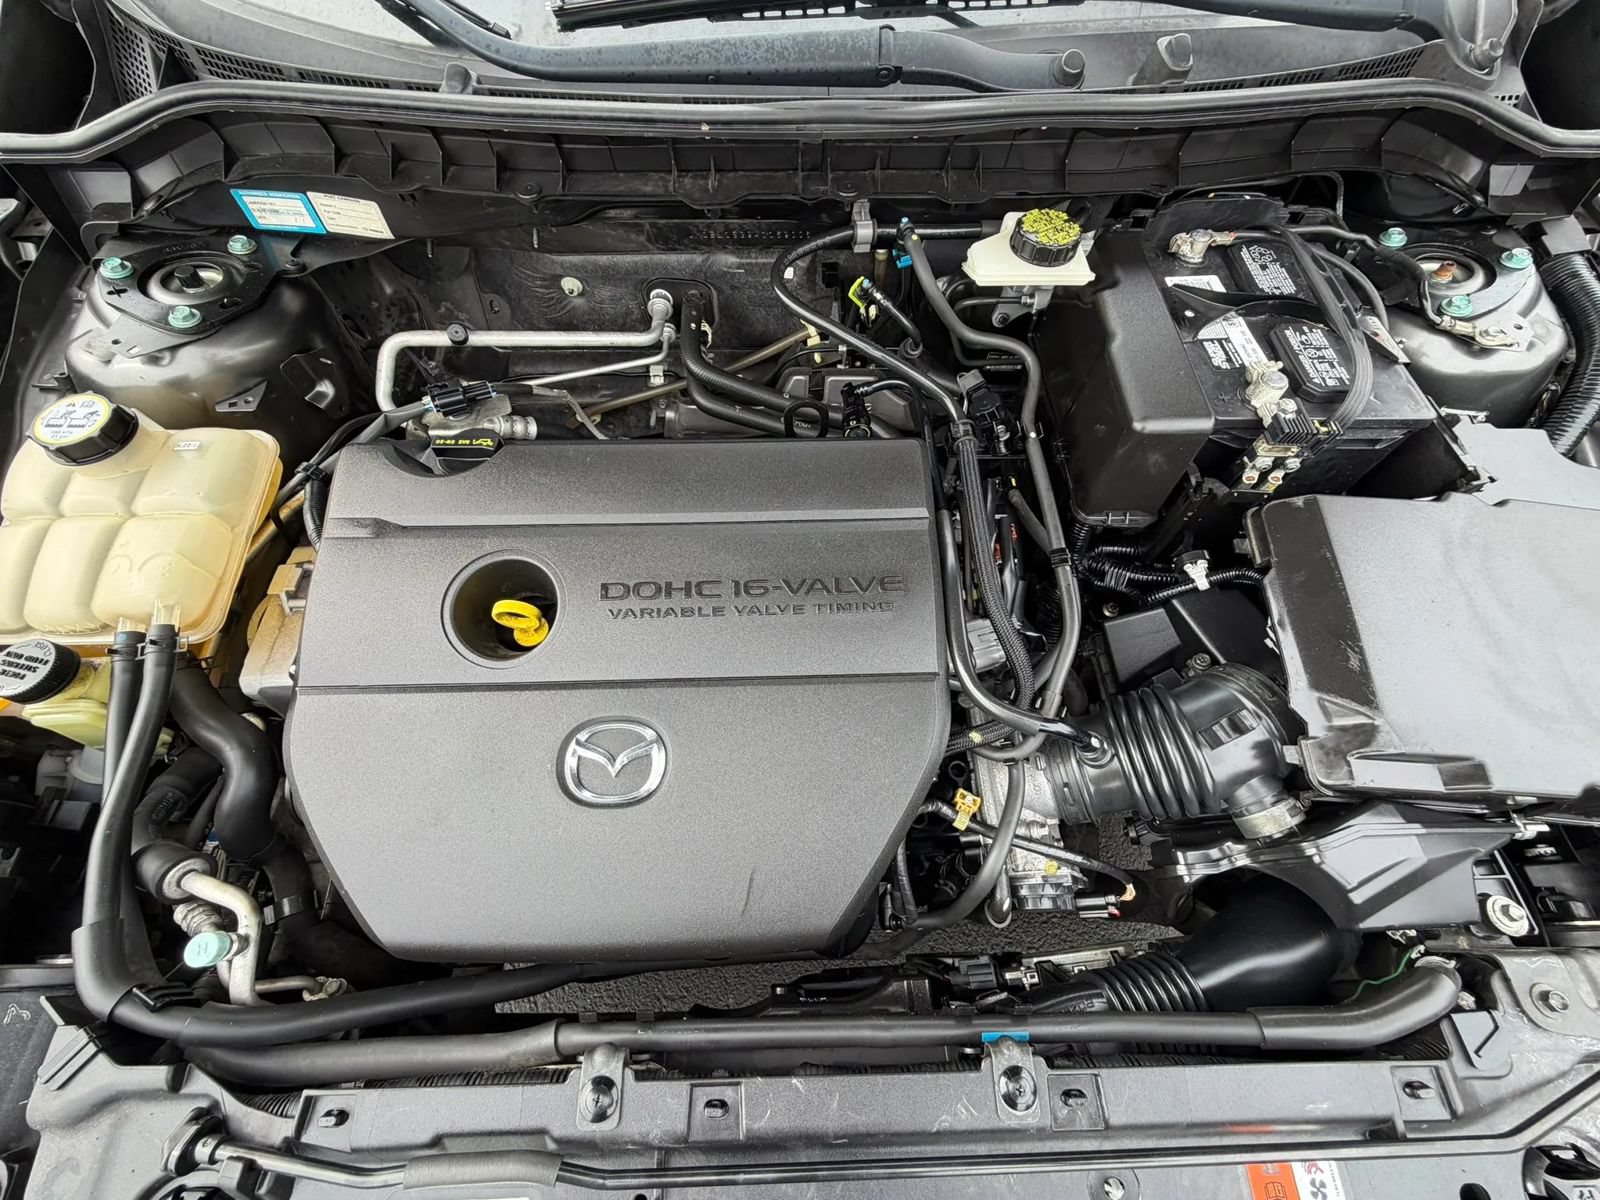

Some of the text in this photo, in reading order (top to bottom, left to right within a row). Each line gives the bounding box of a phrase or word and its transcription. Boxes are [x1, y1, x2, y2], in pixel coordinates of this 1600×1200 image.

[600, 575, 906, 601] DOHC 16-VALVE
[607, 600, 897, 620] VARIABLE VALVE TIMING
